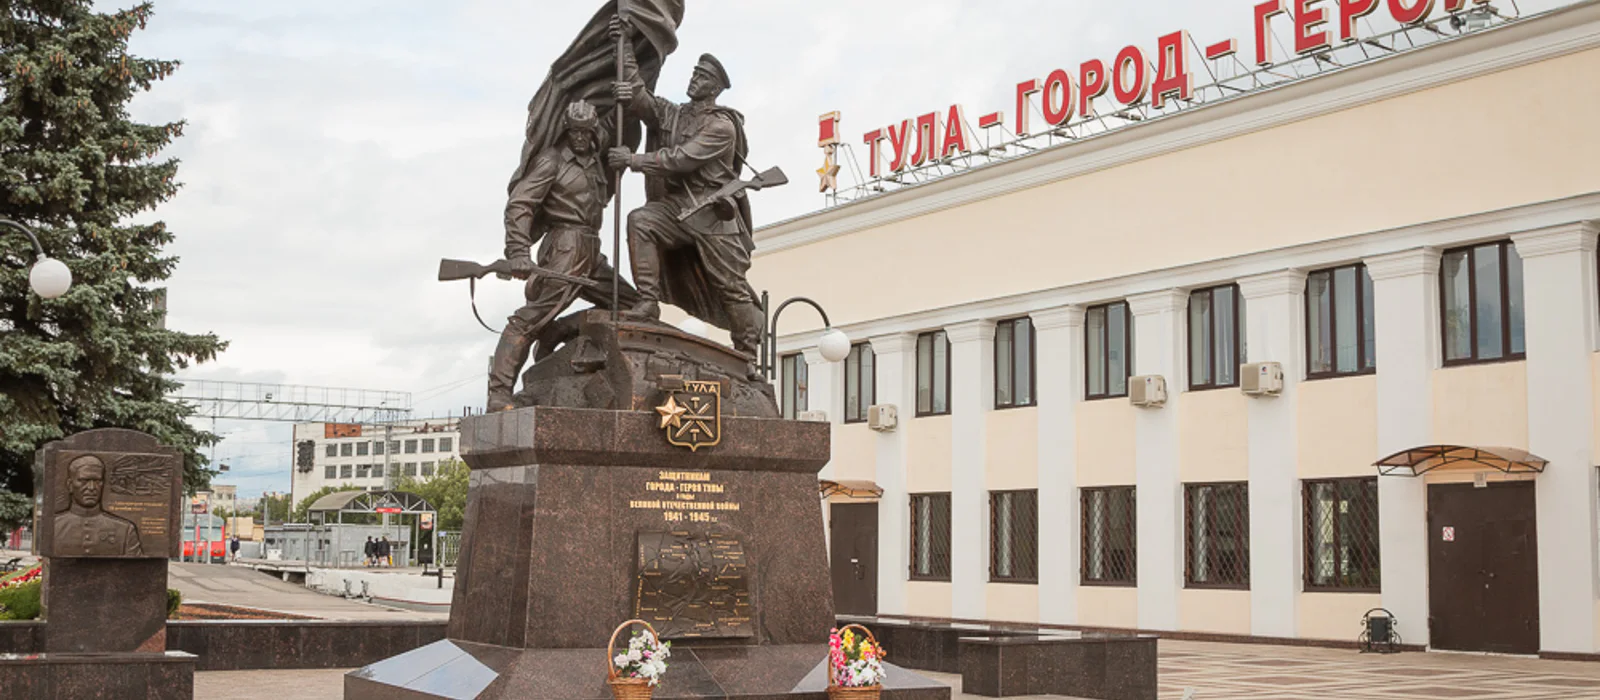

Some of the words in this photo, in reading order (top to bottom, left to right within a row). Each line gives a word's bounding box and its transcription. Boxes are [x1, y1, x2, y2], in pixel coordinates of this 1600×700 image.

[863, 103, 971, 179] ТУЛА
[1015, 29, 1195, 138] ГОРОД
[1253, 0, 1492, 66] ГЕР
[684, 382, 717, 393] ТУЛА
[659, 471, 711, 480] ЗАЩИТНИКАМ
[646, 482, 675, 492] ГОРОДА
[664, 511, 682, 521] 1941
[689, 512, 709, 522] 1945
